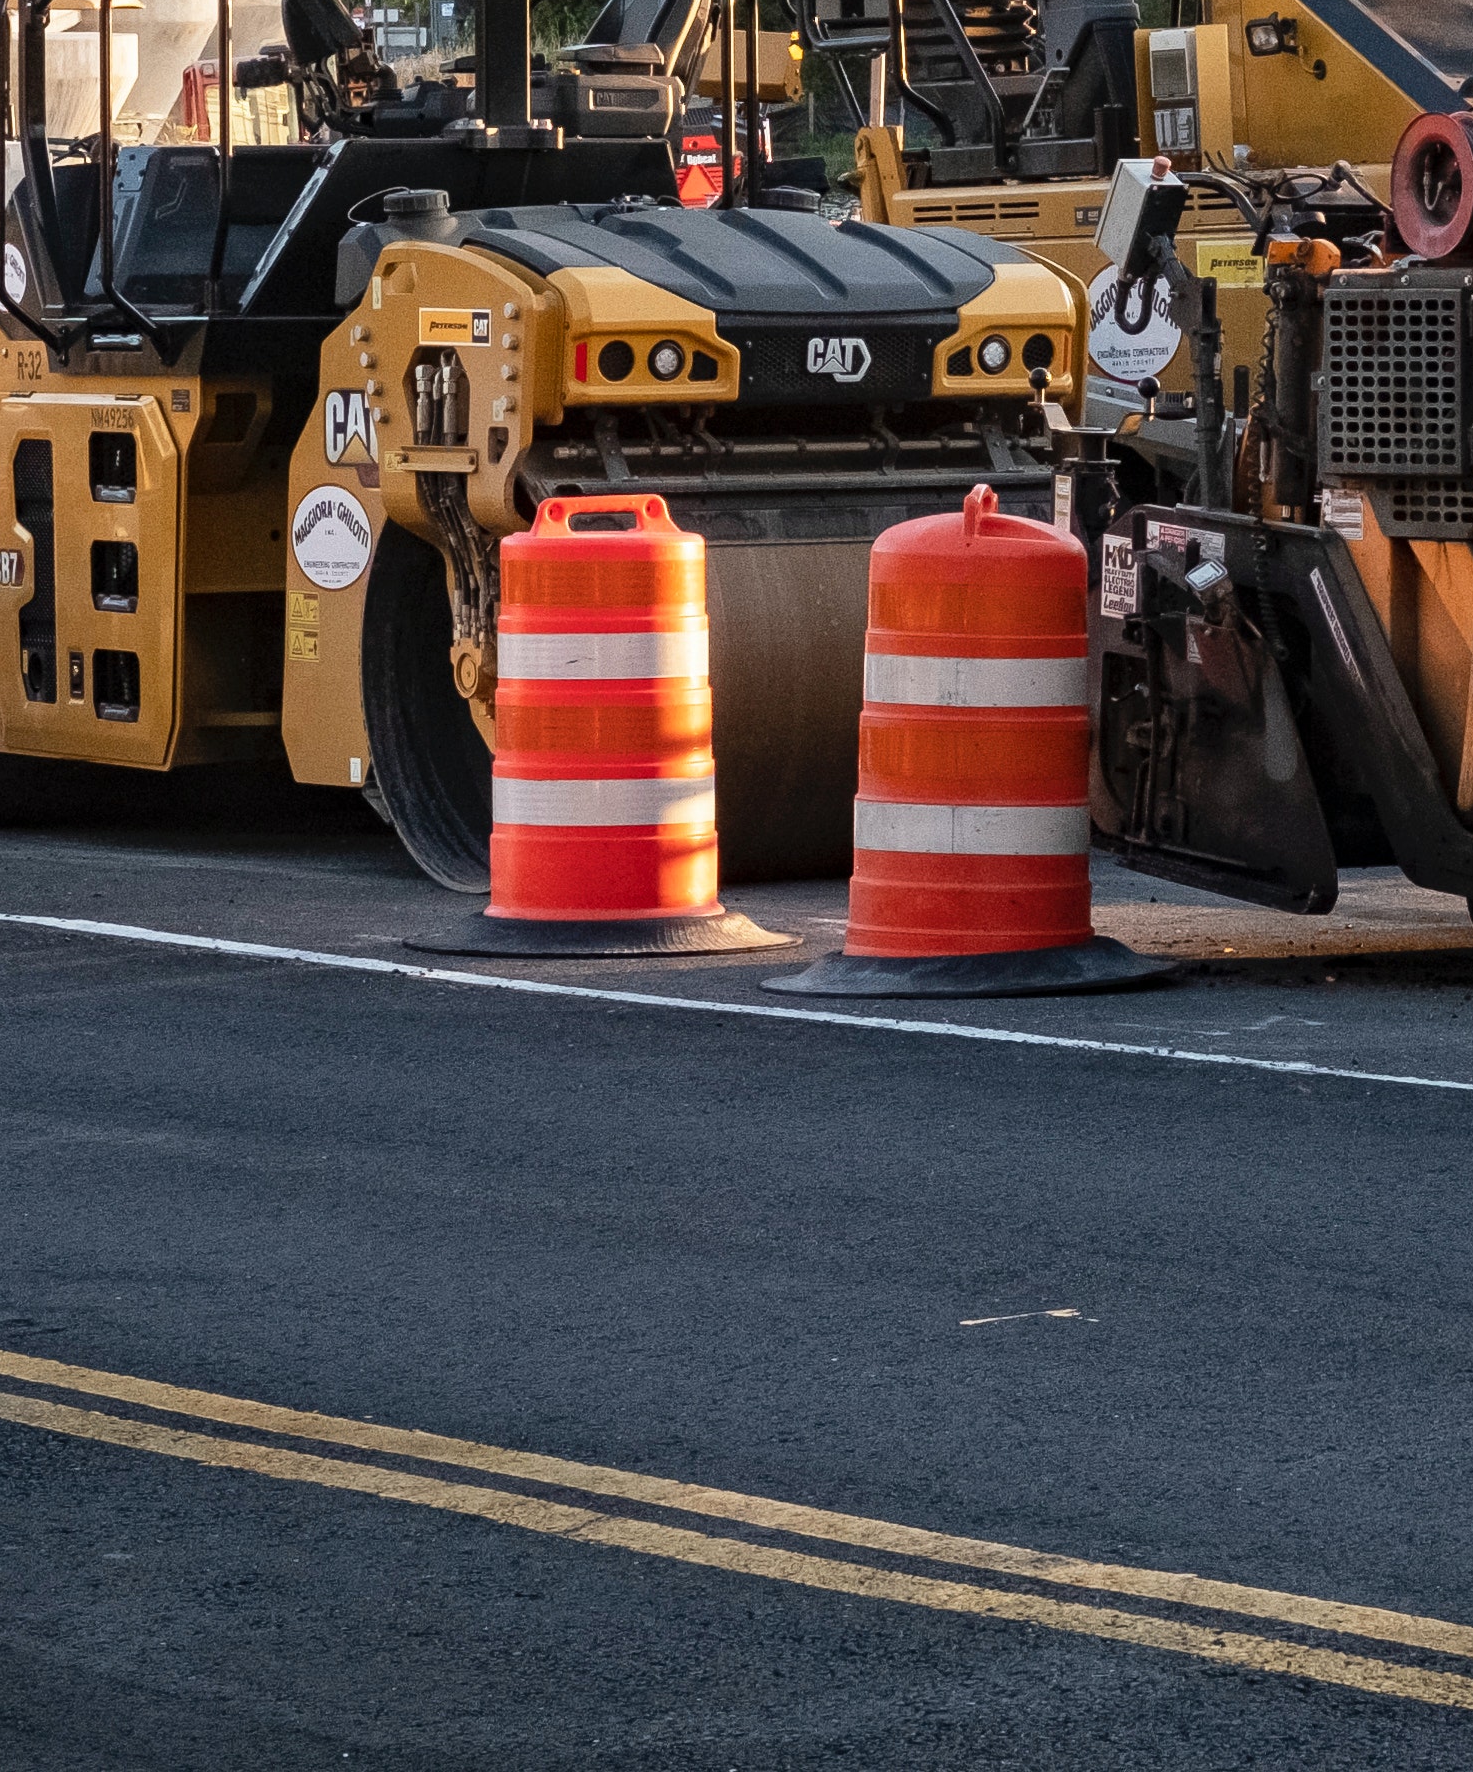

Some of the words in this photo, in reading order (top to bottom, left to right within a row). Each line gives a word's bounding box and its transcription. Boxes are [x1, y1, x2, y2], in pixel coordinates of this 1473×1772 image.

[686, 153, 717, 166] Bobcat
[1210, 258, 1258, 270] PETERSON
[429, 321, 468, 333] PETERSON
[473, 318, 489, 337] CAT
[807, 338, 863, 375] CAT
[1132, 346, 1170, 358] CONTRACTORS
[17, 350, 42, 381] R-32
[294, 500, 333, 548] MAGGIORA
[337, 501, 369, 548] GHILOTTI
[1104, 584, 1135, 598] LEGEND
